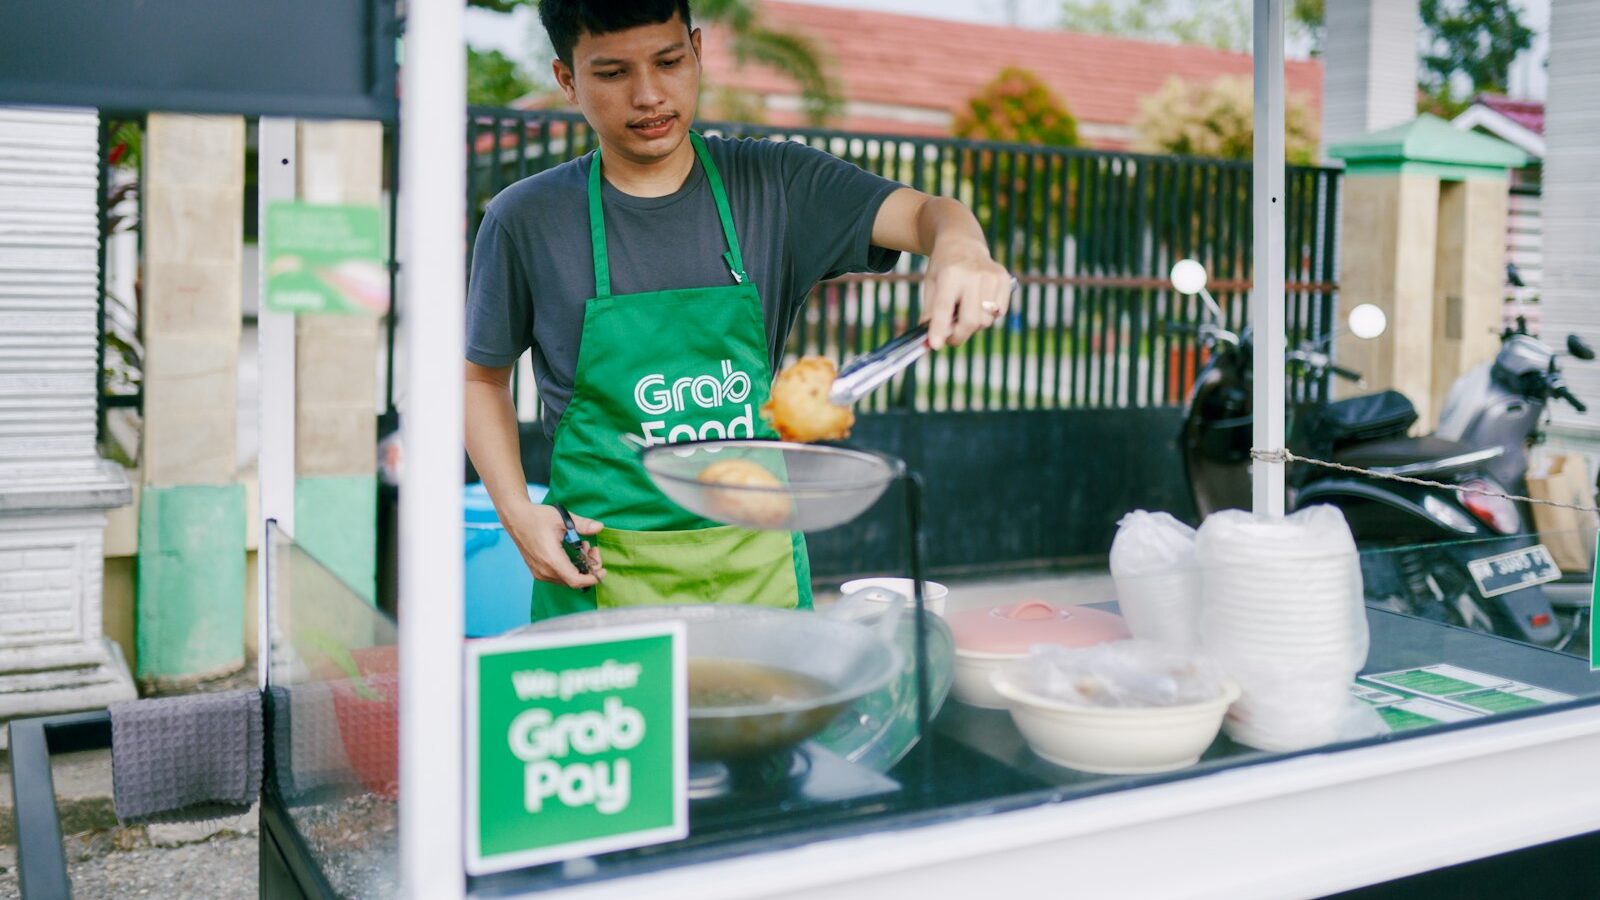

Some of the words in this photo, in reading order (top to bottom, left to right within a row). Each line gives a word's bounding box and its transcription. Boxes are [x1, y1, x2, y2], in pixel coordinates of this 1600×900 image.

[634, 359, 752, 415] Grab
[641, 403, 755, 457] Food
[511, 669, 558, 700] We
[558, 659, 642, 701] prefer
[508, 696, 646, 762] Grab
[524, 758, 631, 814] Pay
